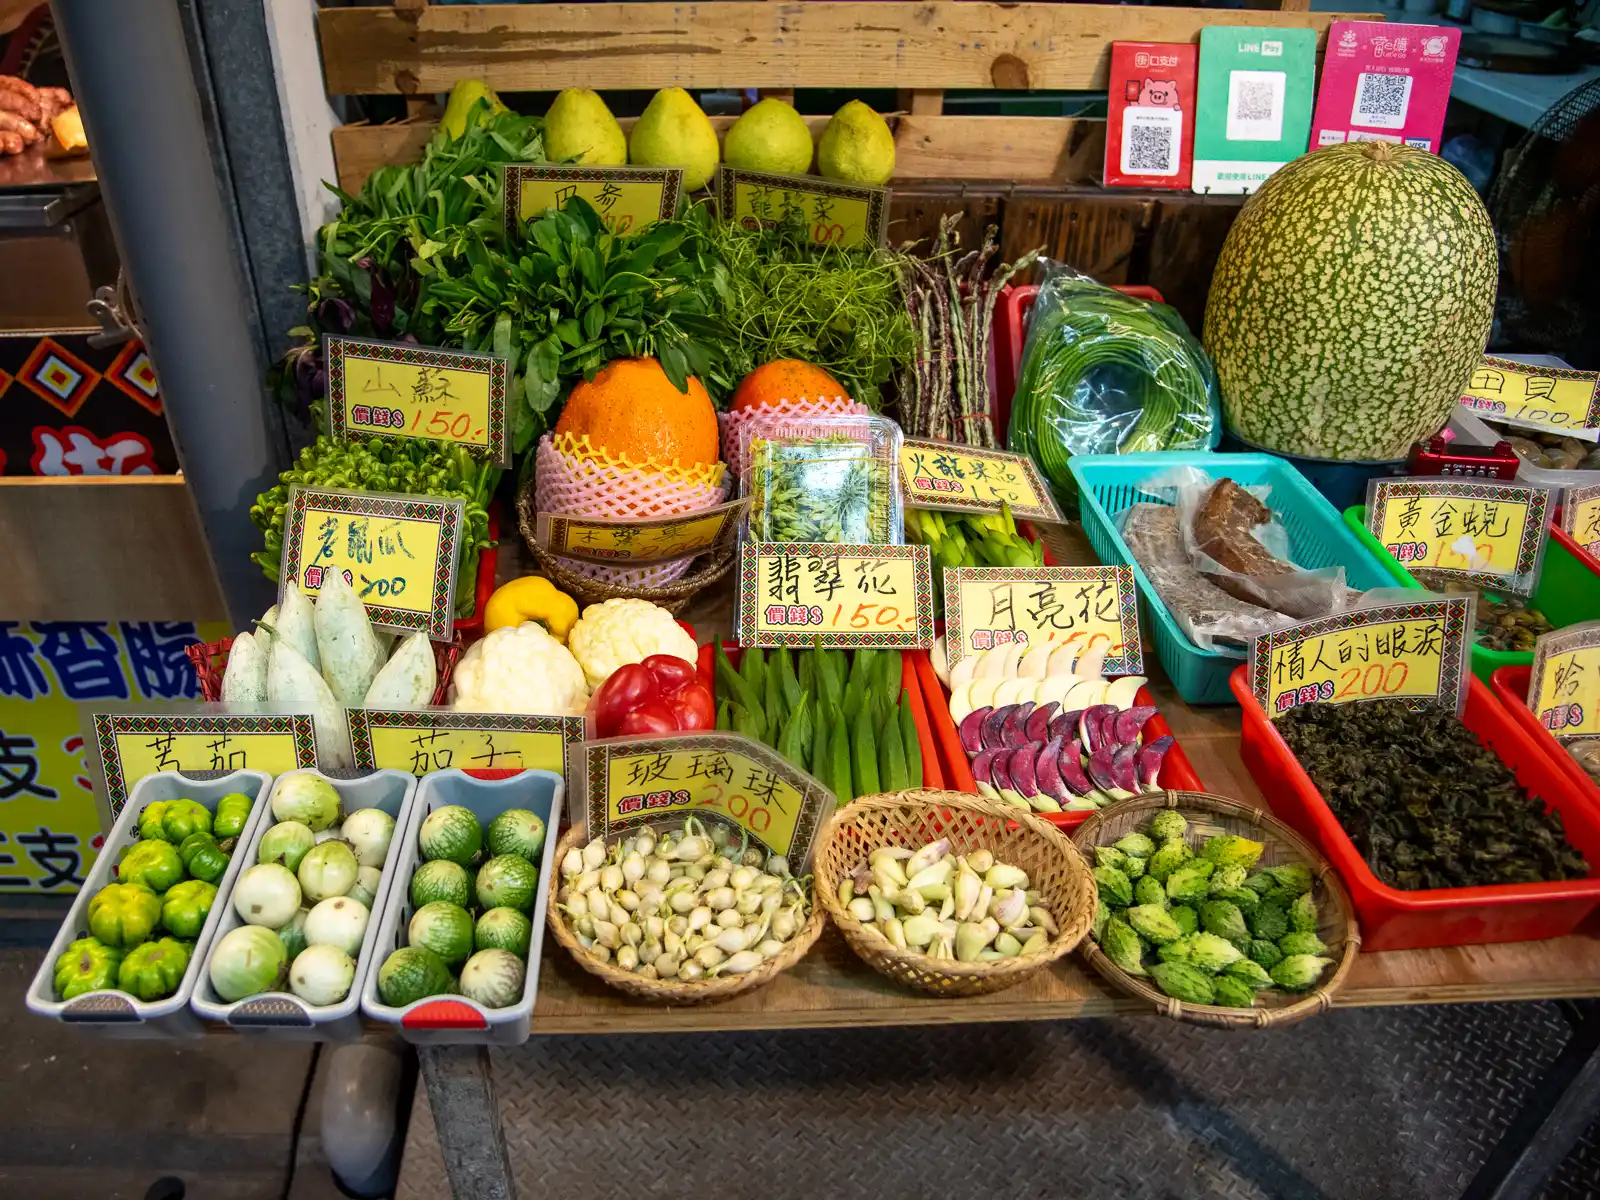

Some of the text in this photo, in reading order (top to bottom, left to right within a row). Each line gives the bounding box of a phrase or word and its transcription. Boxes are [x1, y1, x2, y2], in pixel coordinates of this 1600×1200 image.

[1238, 43, 1260, 53] LINE
[1409, 141, 1427, 150] VISA
[362, 366, 460, 407] 山蘇
[768, 554, 897, 604] 翡翠花
[989, 579, 1122, 632] 月亮花
[1274, 618, 1448, 685] 情人的眼淚
[1335, 661, 1409, 701] 200
[627, 751, 788, 816] 玻璃珠
[696, 783, 771, 833] 200
